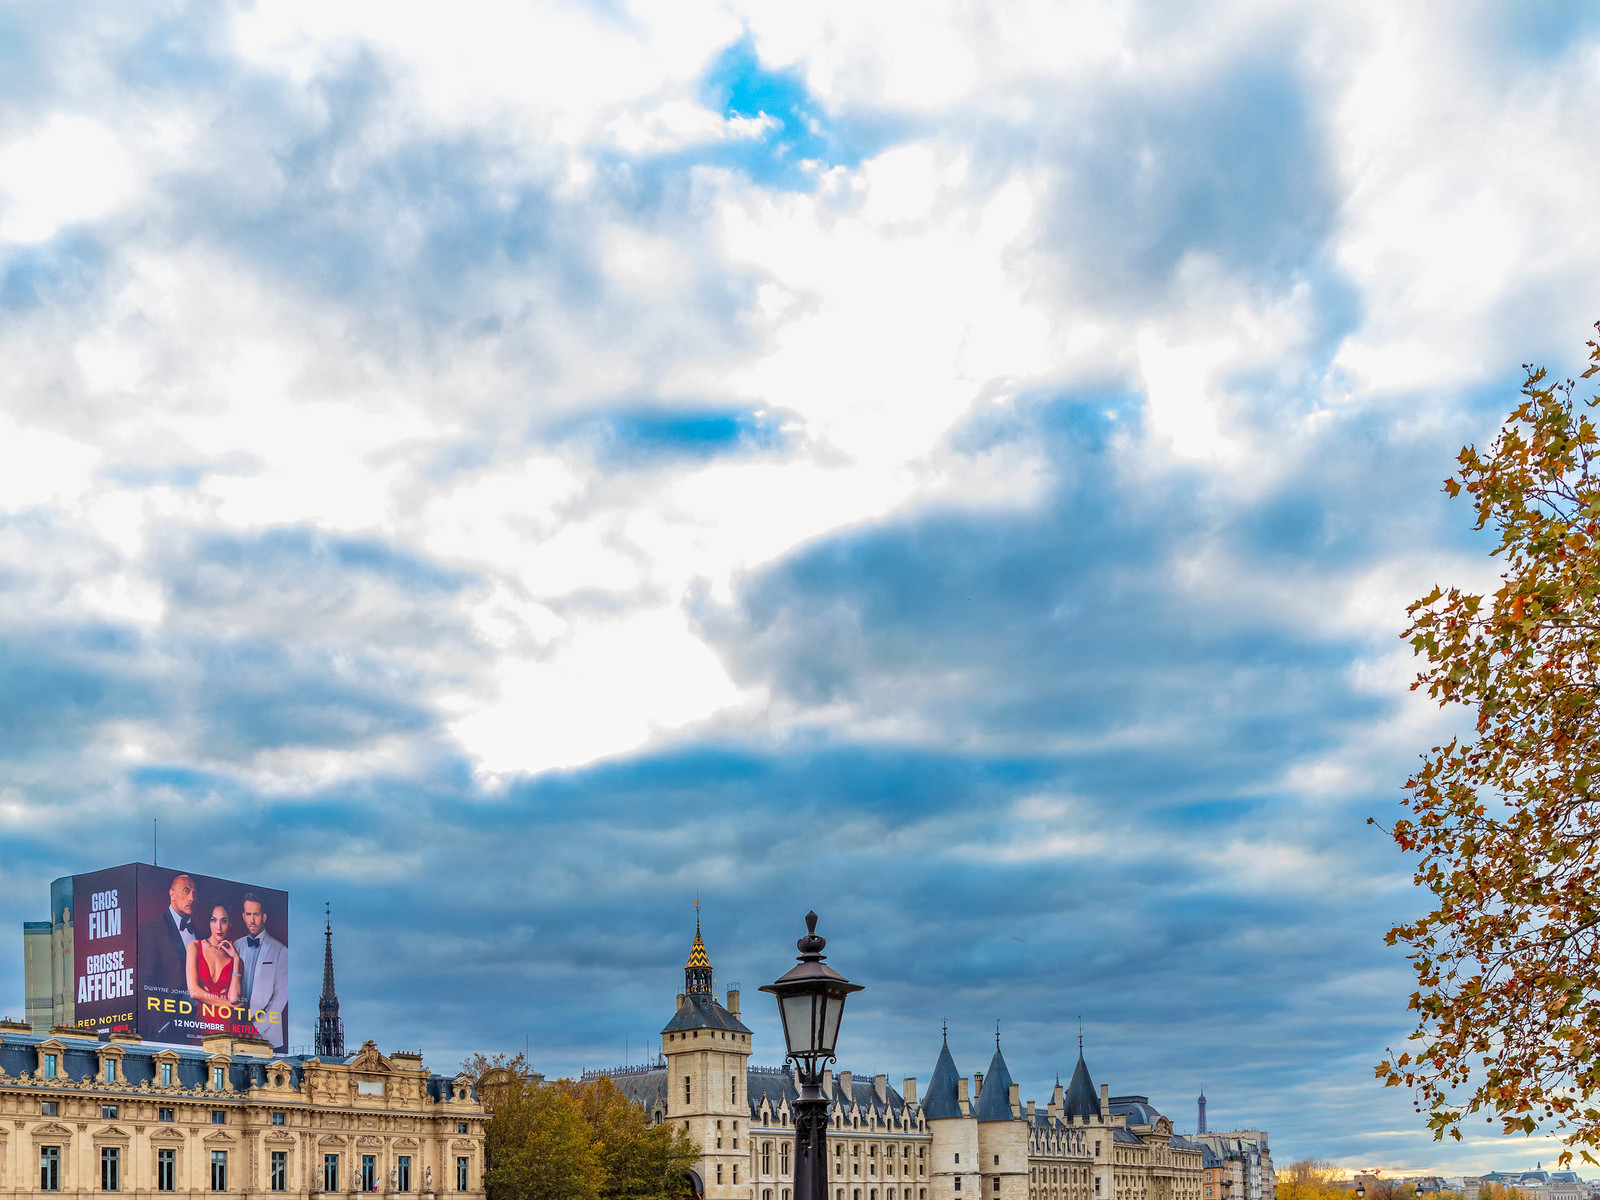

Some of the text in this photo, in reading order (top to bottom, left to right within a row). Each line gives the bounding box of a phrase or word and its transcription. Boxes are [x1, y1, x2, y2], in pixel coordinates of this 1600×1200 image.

[92, 889, 118, 912] GROS
[88, 908, 122, 940] FILM
[86, 950, 124, 974] GROSSE
[78, 968, 134, 1004] AFFICHE
[144, 984, 169, 994] DWAYNE
[171, 988, 198, 996] JOHNSON
[220, 994, 248, 1002] REYNOLDS
[77, 1012, 133, 1028] RED NOTICE
[147, 996, 280, 1024] RED NOTICE
[183, 1020, 224, 1031] NOVEMBRE
[232, 1024, 258, 1035] NETFLIX
